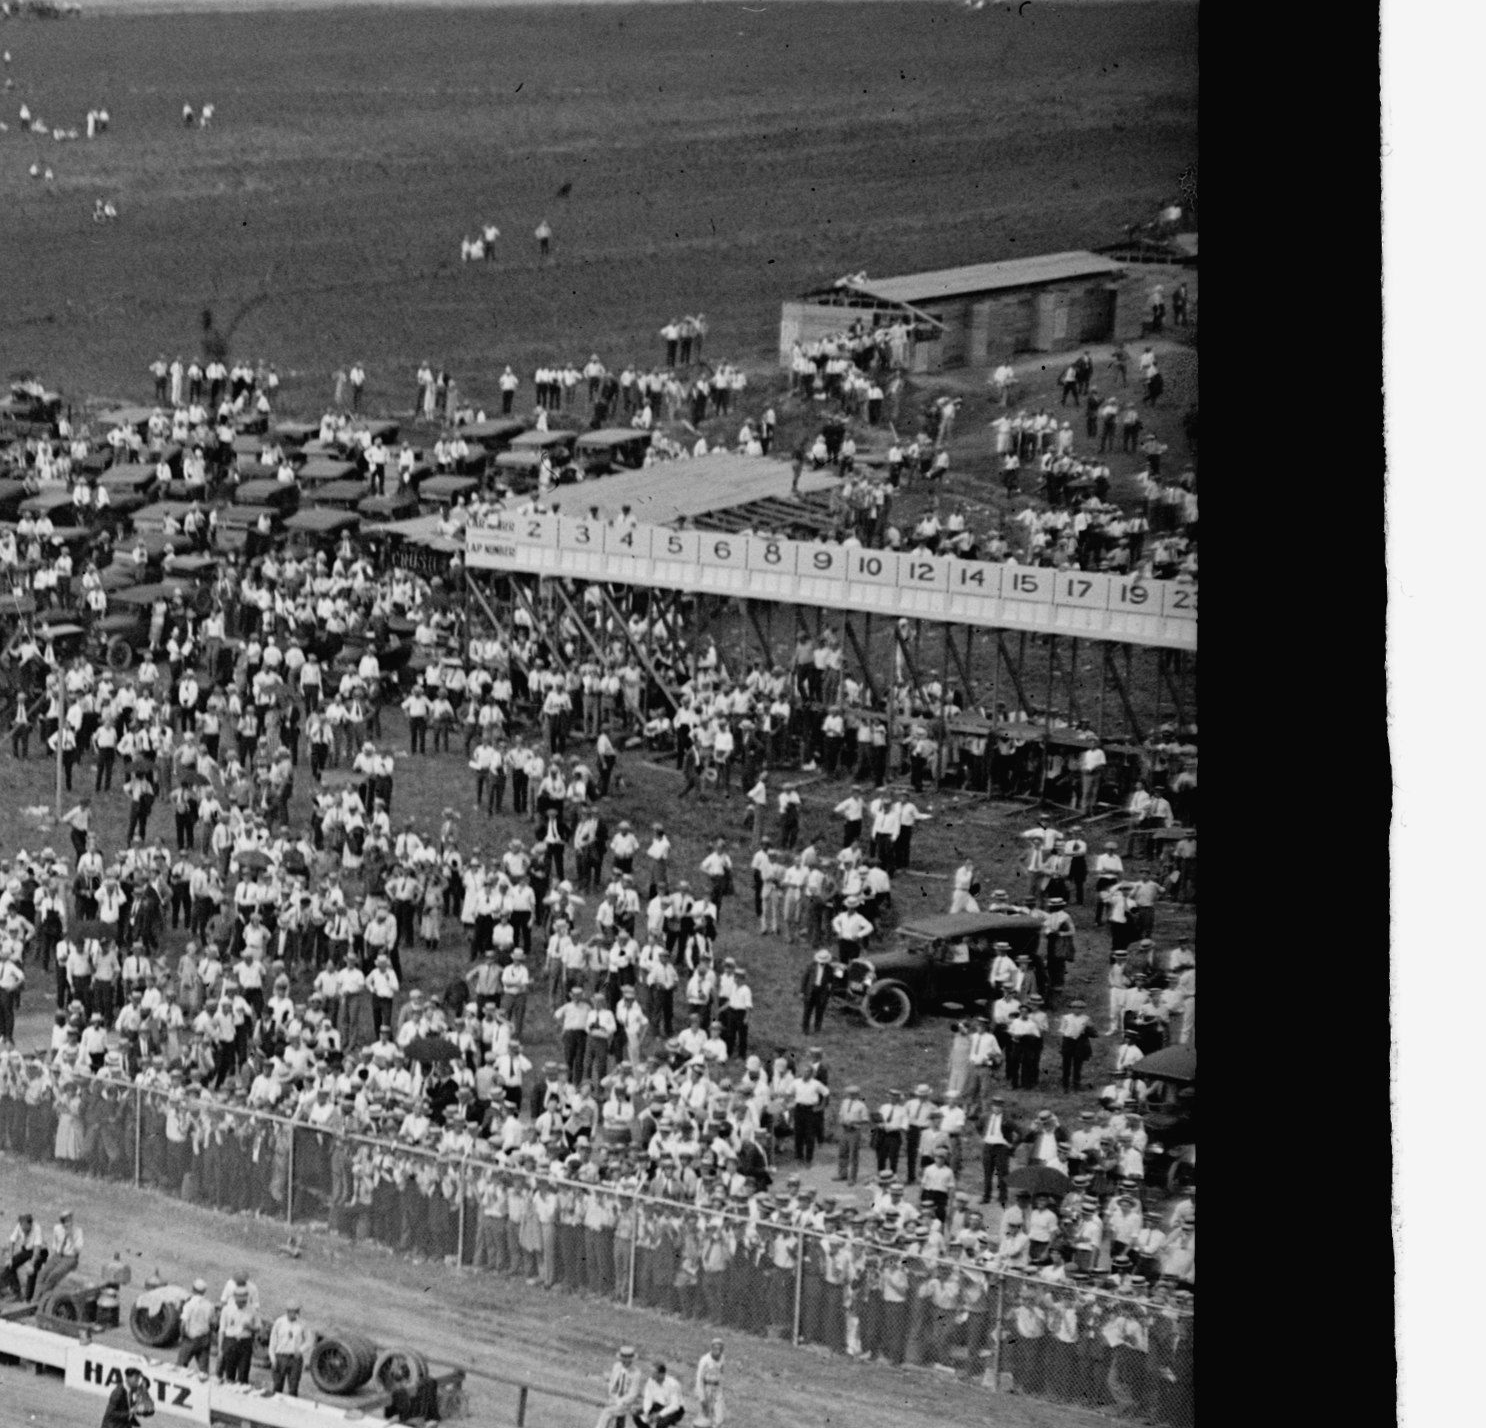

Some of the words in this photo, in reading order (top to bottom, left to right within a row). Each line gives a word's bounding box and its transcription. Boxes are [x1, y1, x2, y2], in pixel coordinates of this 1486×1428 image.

[527, 521, 541, 538] 2
[575, 525, 590, 544] 3
[621, 531, 633, 547] 4
[667, 536, 682, 553] 5
[714, 540, 731, 559] 6
[764, 542, 782, 564] 8
[813, 551, 833, 570] 9
[859, 557, 882, 576] 10
[910, 562, 935, 581] 12
[961, 568, 985, 587] 14
[1013, 573, 1038, 593] 15
[1067, 579, 1092, 598] 17
[1121, 584, 1148, 604] 19
[83, 1359, 194, 1410] HATZ
